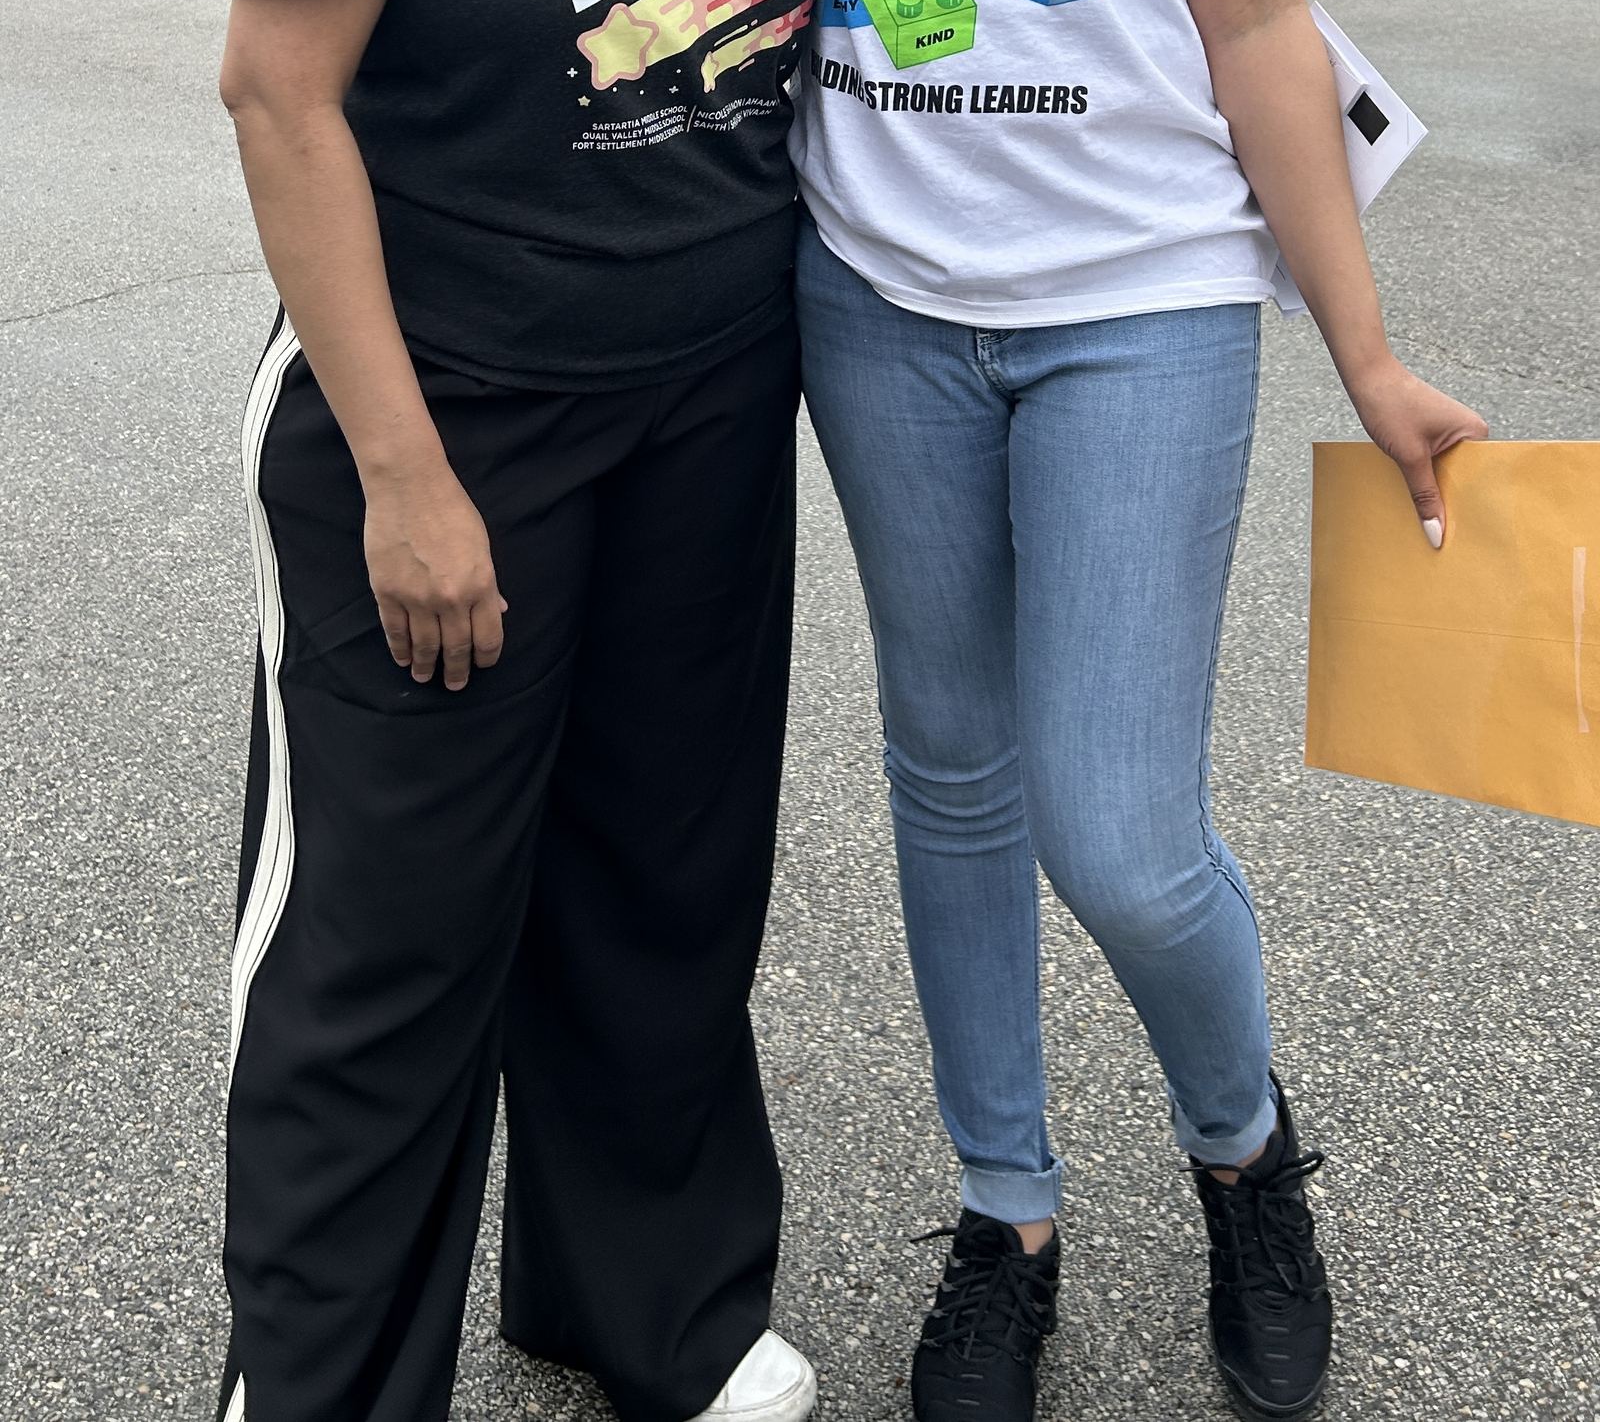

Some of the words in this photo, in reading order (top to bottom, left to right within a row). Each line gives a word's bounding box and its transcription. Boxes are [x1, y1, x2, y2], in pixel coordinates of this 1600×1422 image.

[915, 28, 955, 49] KIND
[864, 80, 964, 114] STRONG
[970, 84, 1089, 115] LEADERS
[582, 131, 609, 140] QUAIL
[611, 129, 643, 140] VALLEY
[661, 114, 686, 128] SCHOOL
[592, 118, 640, 131] SARTARTIA
[659, 105, 688, 118] SCHOOL
[572, 142, 594, 151] FORT
[596, 138, 647, 151] SETTLEMENT
